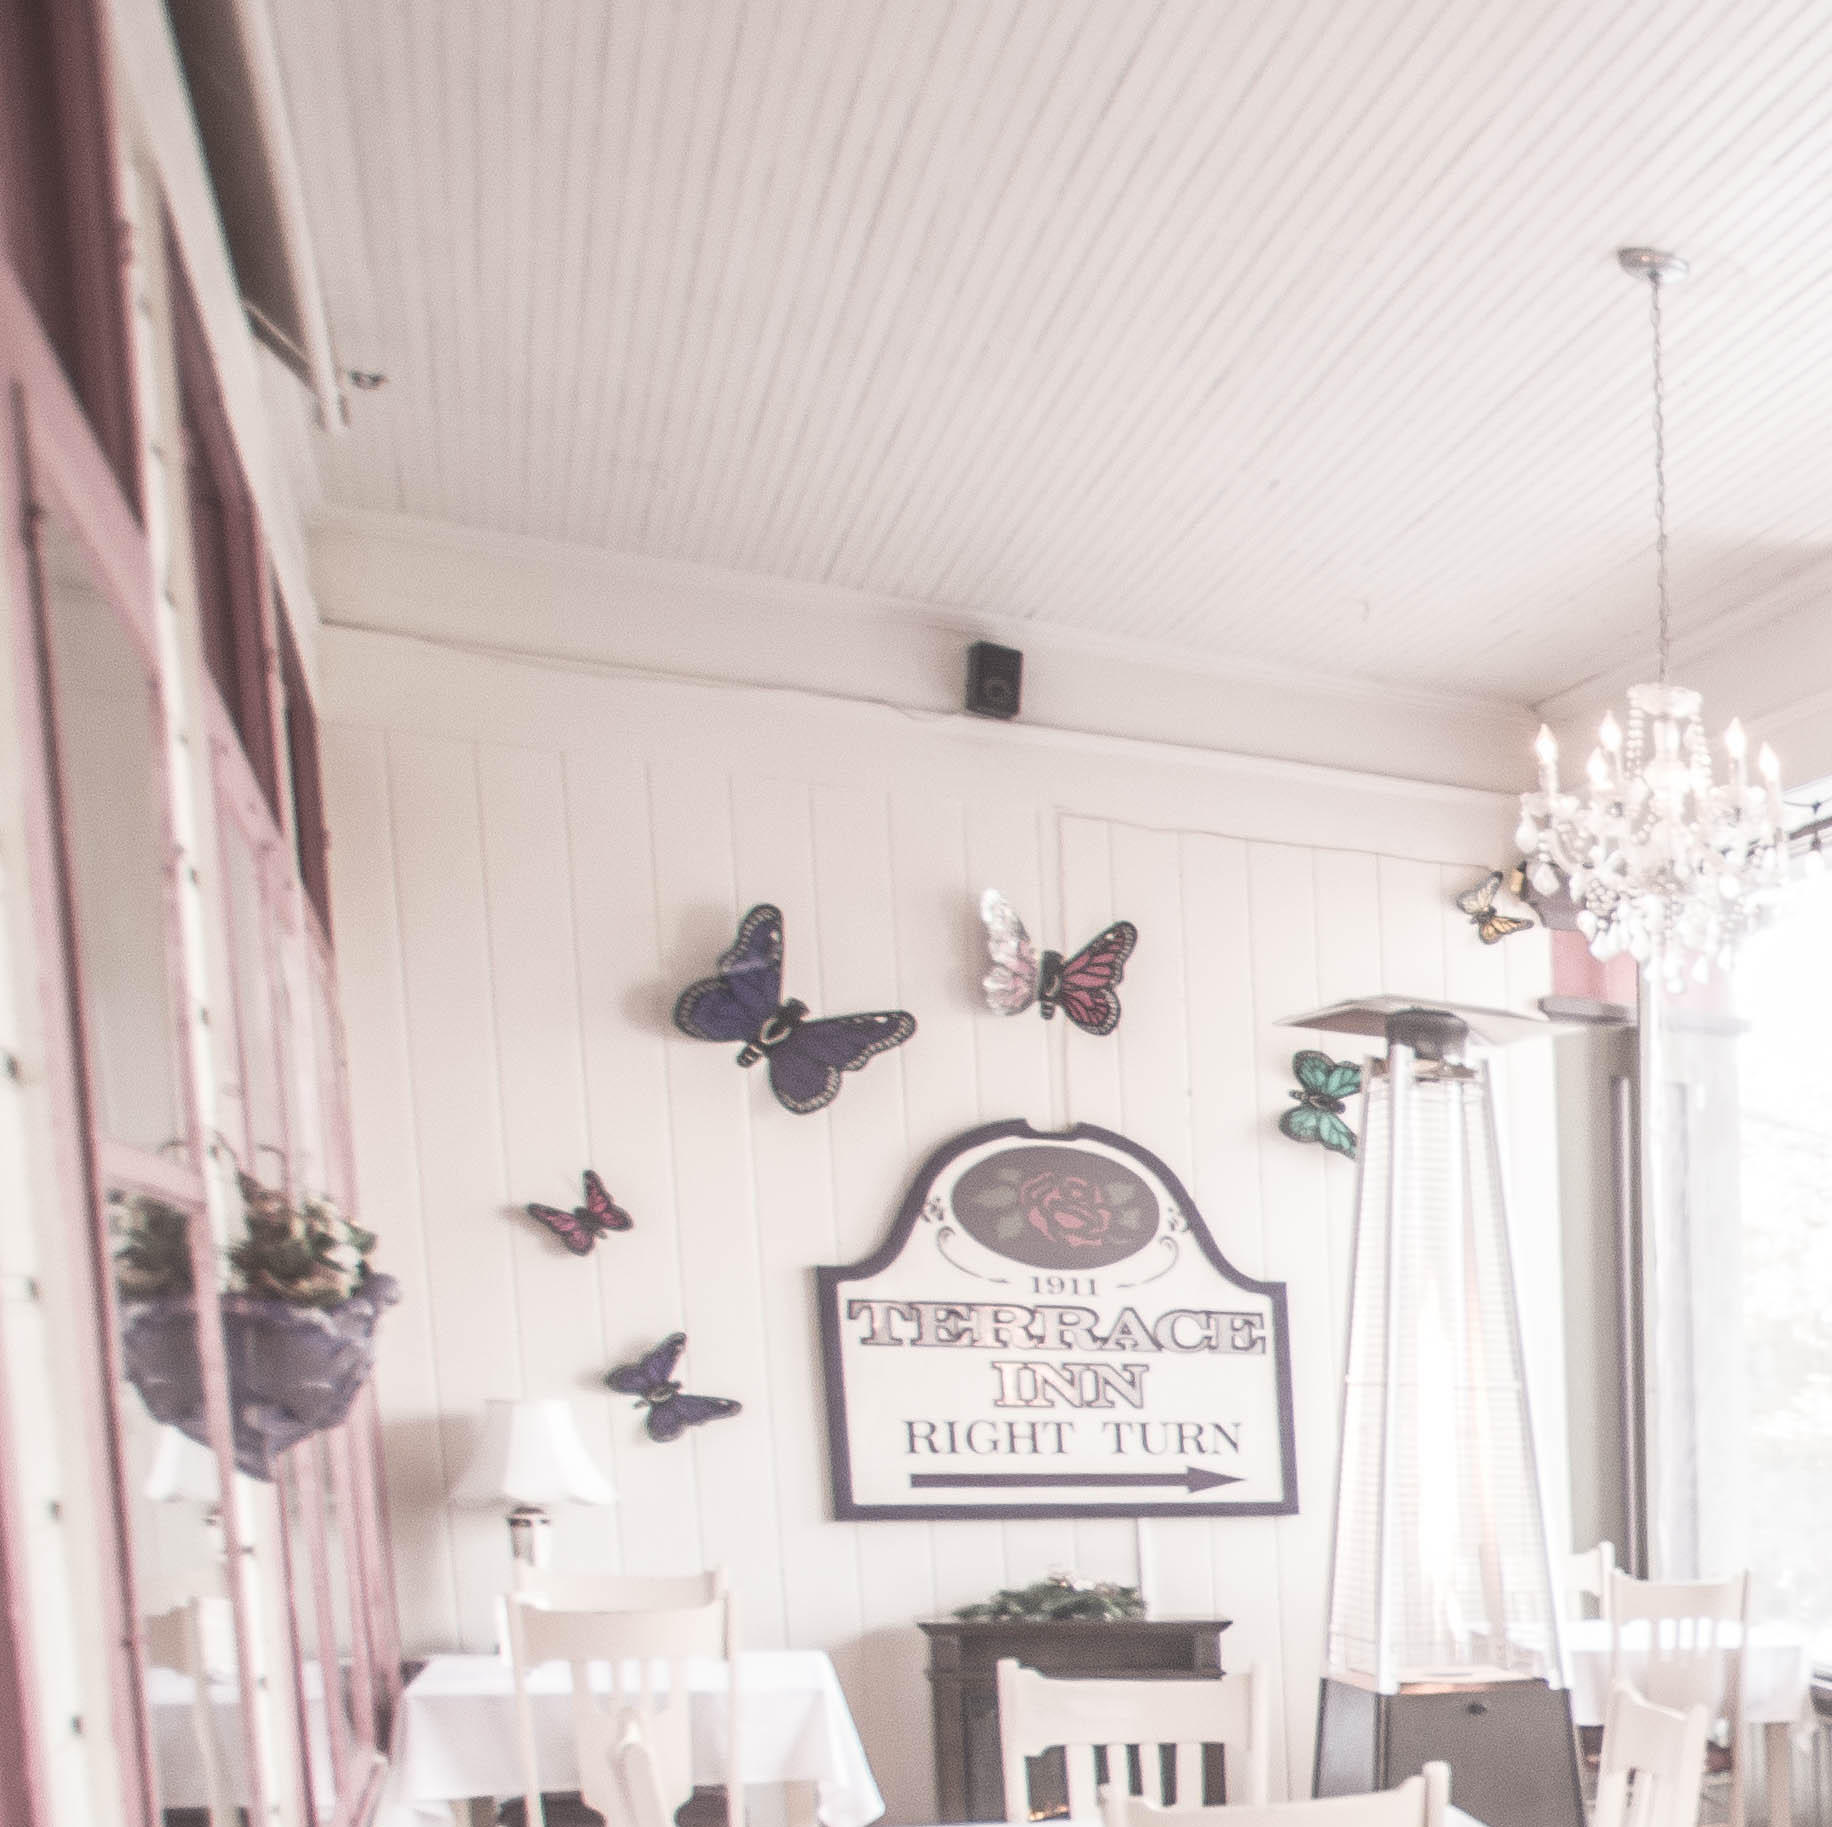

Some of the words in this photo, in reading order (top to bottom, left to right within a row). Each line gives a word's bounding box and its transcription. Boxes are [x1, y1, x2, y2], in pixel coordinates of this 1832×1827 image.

[1030, 1275, 1100, 1297] 1911
[846, 1299, 1266, 1355] TERRACE
[991, 1360, 1150, 1409] INN
[904, 1420, 1074, 1455] RIGHT
[1102, 1420, 1243, 1456] TURN
